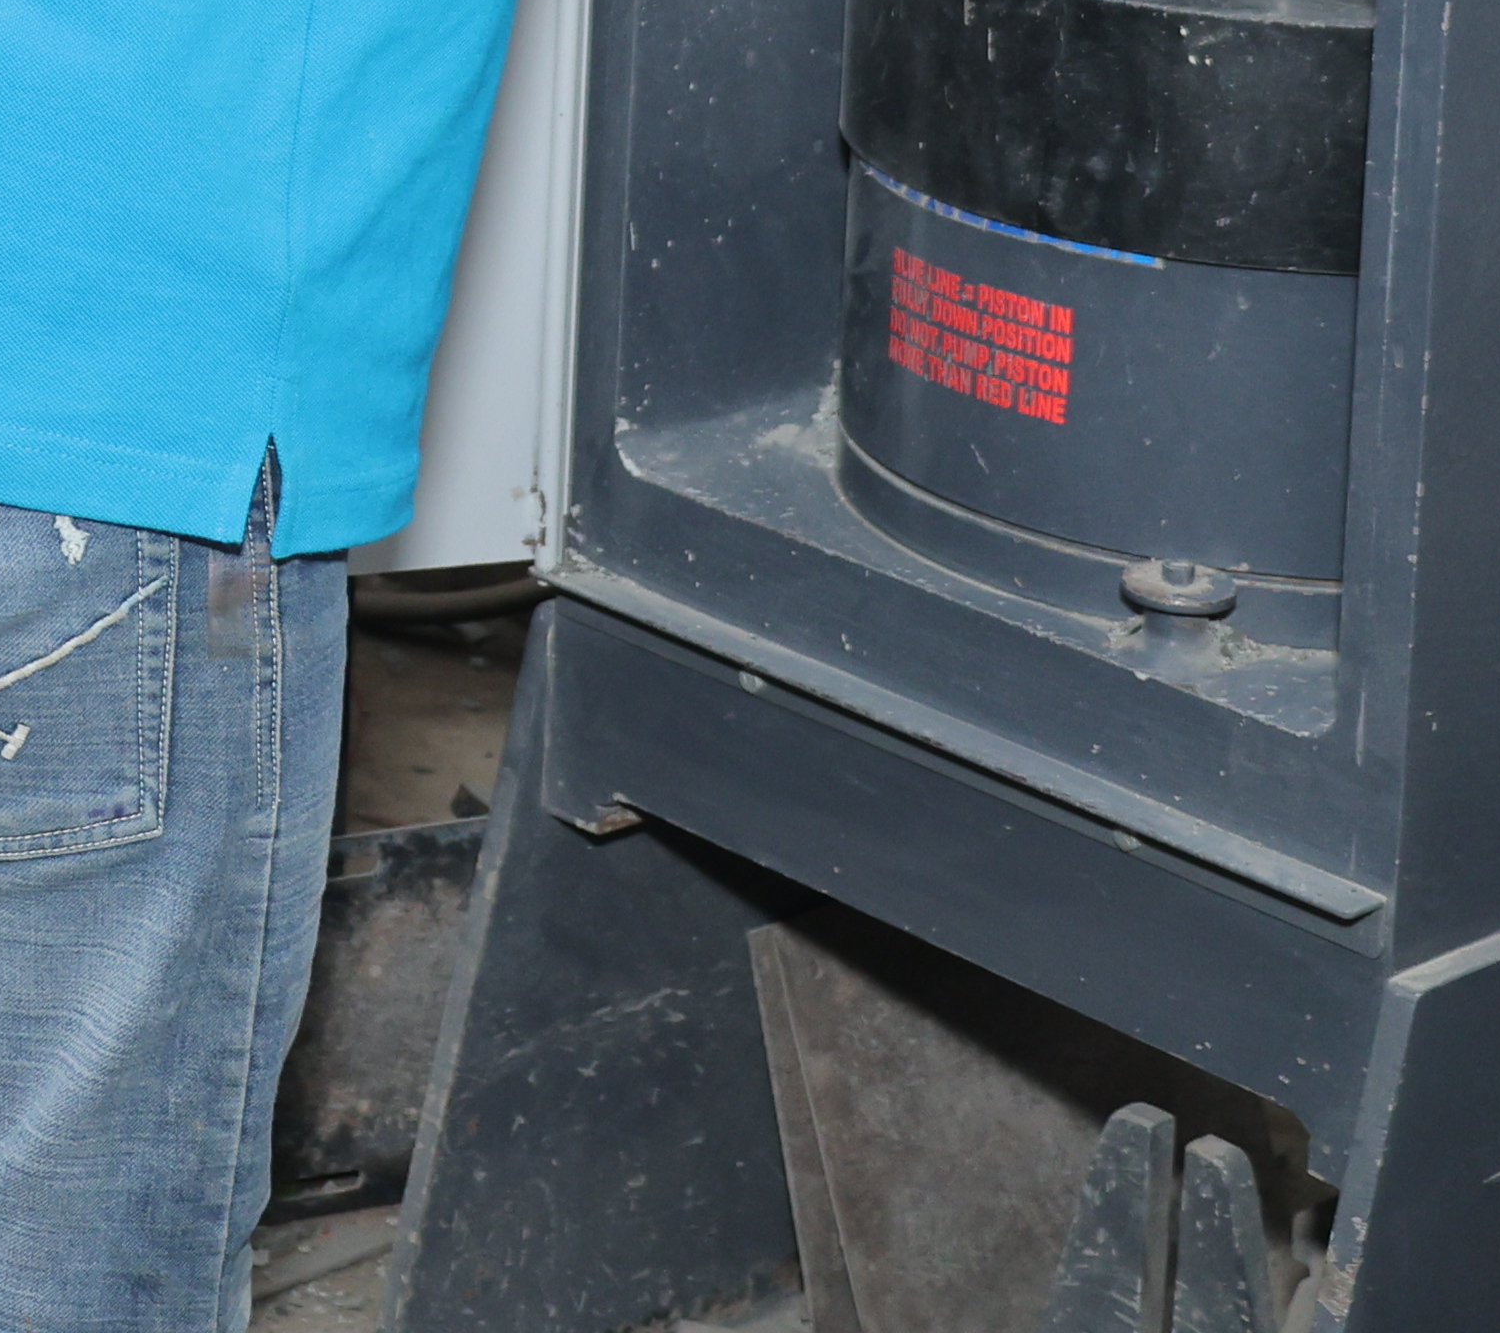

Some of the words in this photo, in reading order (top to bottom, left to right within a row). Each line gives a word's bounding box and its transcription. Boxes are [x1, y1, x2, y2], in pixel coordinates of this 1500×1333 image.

[891, 274, 930, 316] FULLY
[931, 295, 979, 337] DOWN
[981, 314, 1074, 364] POSITION
[926, 264, 963, 301] LINE
[977, 283, 1045, 328] PISTON
[1049, 303, 1074, 334] IN
[888, 334, 926, 376] MORE
[927, 355, 973, 396] THAN
[975, 373, 1014, 409] RED
[1017, 385, 1068, 425] LINE
[890, 305, 907, 337] DO
[908, 317, 939, 351] NOT
[940, 331, 990, 370] PUMP
[993, 349, 1071, 396] PISTON
